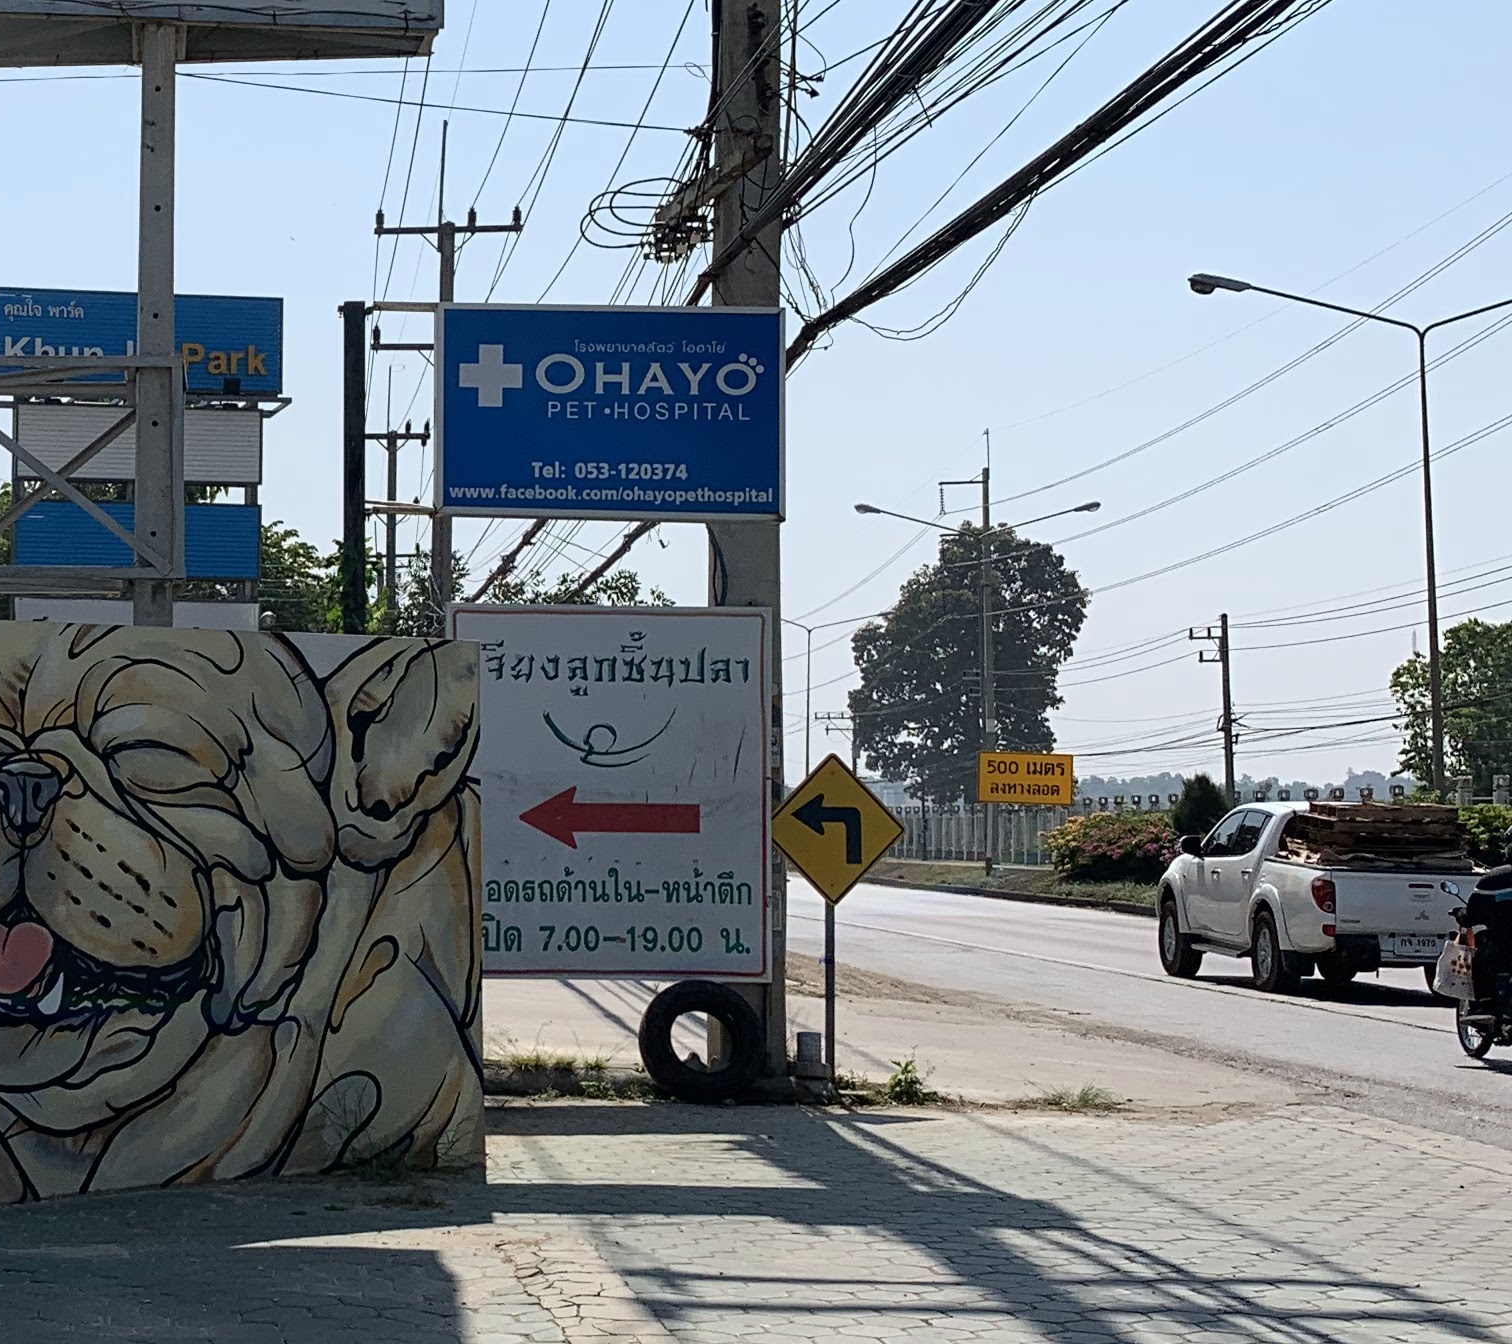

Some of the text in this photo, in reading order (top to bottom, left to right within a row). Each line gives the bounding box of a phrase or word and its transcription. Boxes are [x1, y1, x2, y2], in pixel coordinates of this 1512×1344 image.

[47, 300, 85, 319] พาร์ค
[574, 339, 676, 354] โรงพยาบาลสัตว์
[181, 342, 268, 376] Park
[535, 353, 757, 396] OHAYO
[532, 461, 688, 481] Tel: 053-120374
[449, 483, 774, 506] www.facebook.com/ohayopethospital
[987, 759, 1065, 777] 500 เมตร
[990, 781, 1061, 796] ลงทางลอด
[483, 866, 753, 906] อดรถด้านใน-หน้าตึก
[481, 912, 523, 953] ปิด
[719, 926, 752, 954] น.
